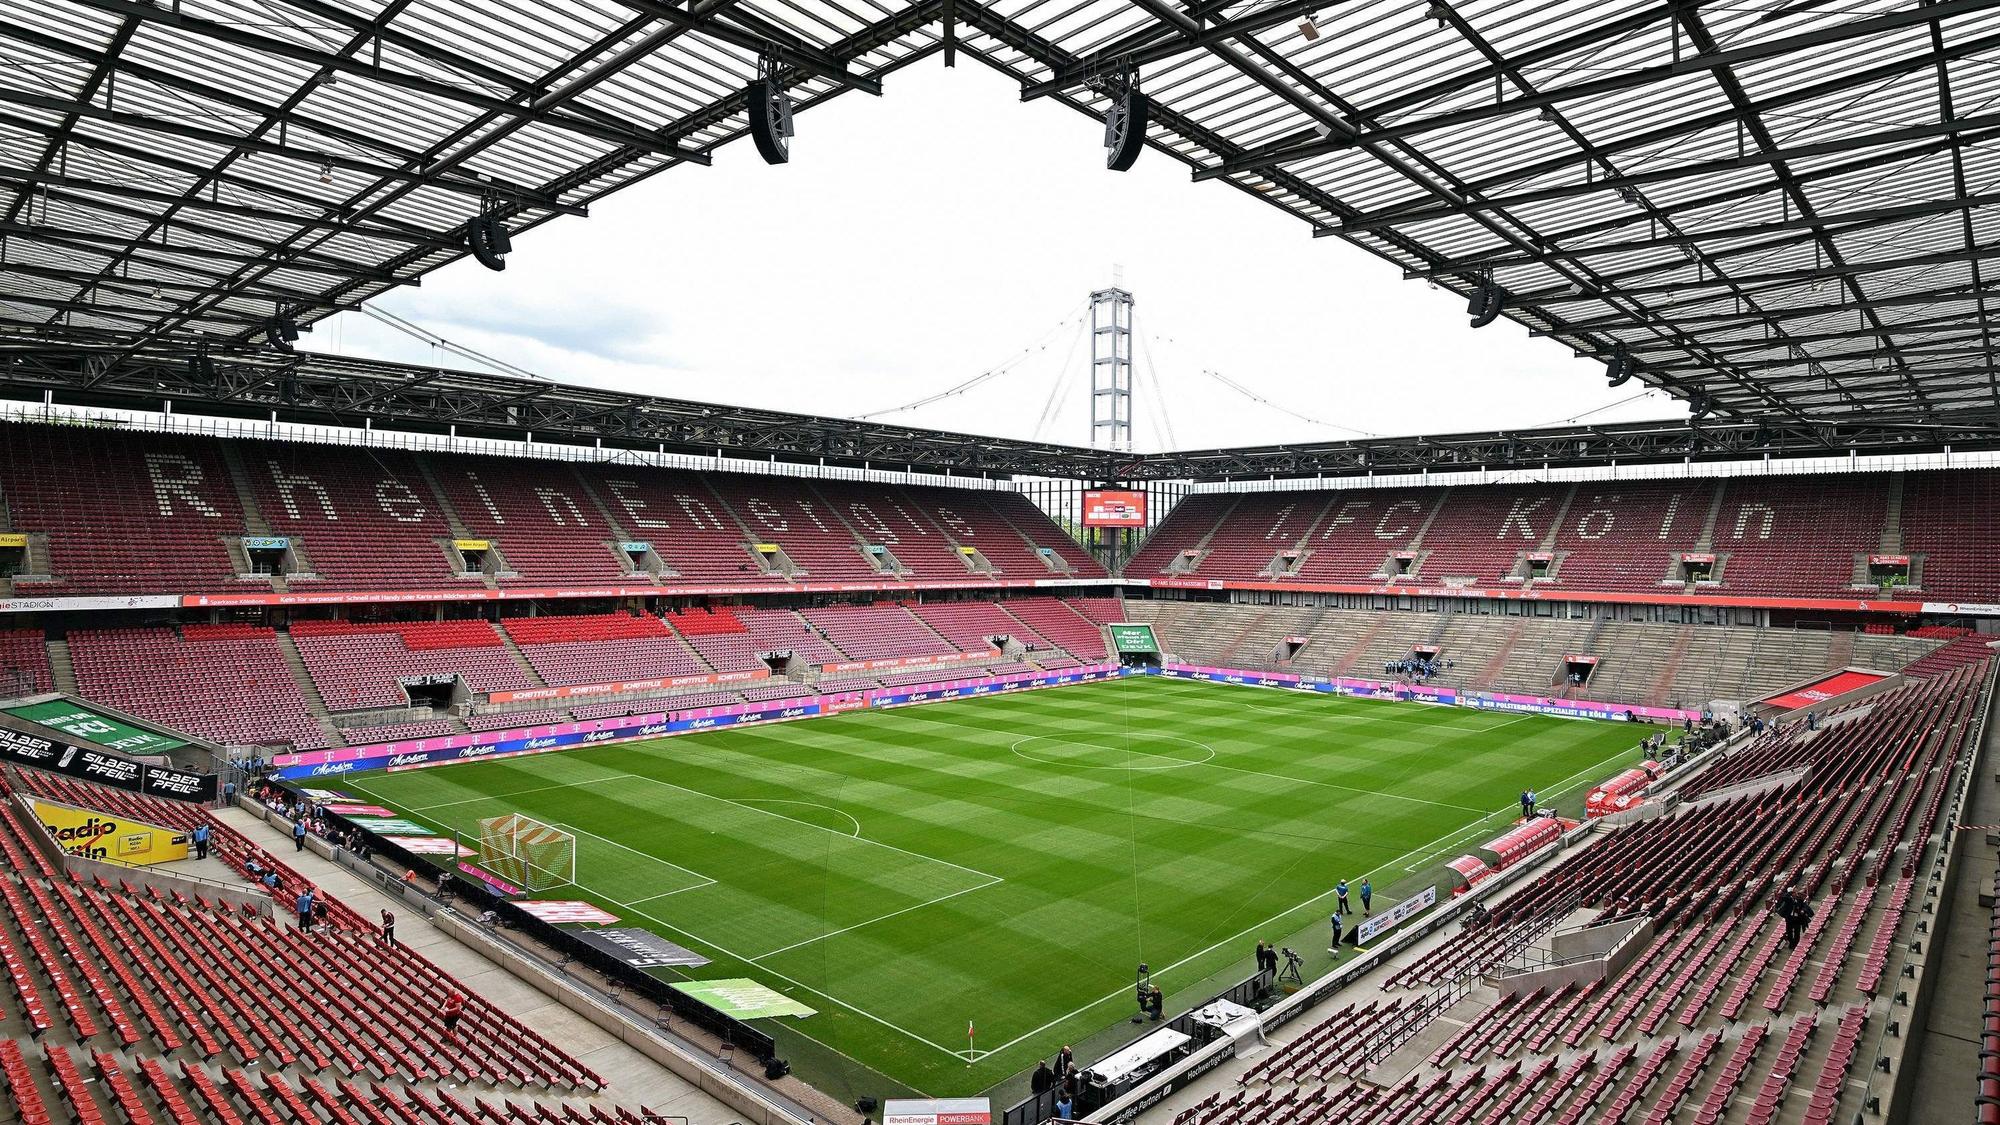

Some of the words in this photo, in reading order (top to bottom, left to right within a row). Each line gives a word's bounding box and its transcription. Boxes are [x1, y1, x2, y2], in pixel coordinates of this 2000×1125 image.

[1322, 500, 1422, 540] FC
[1496, 495, 1776, 540] Köln
[0, 730, 52, 751] SILBER
[0, 741, 40, 758] PFEIL
[82, 752, 137, 772] SILBER
[86, 764, 126, 780] PFEIL
[148, 769, 200, 786] SILBER
[152, 779, 191, 794] PFEIL
[66, 845, 106, 859] öln
[1187, 1057, 1220, 1080] Hochwertige
[1221, 1045, 1234, 1061] Kaffe
[1139, 1091, 1162, 1111] Partner
[890, 1116, 934, 1124] RheinEnergie
